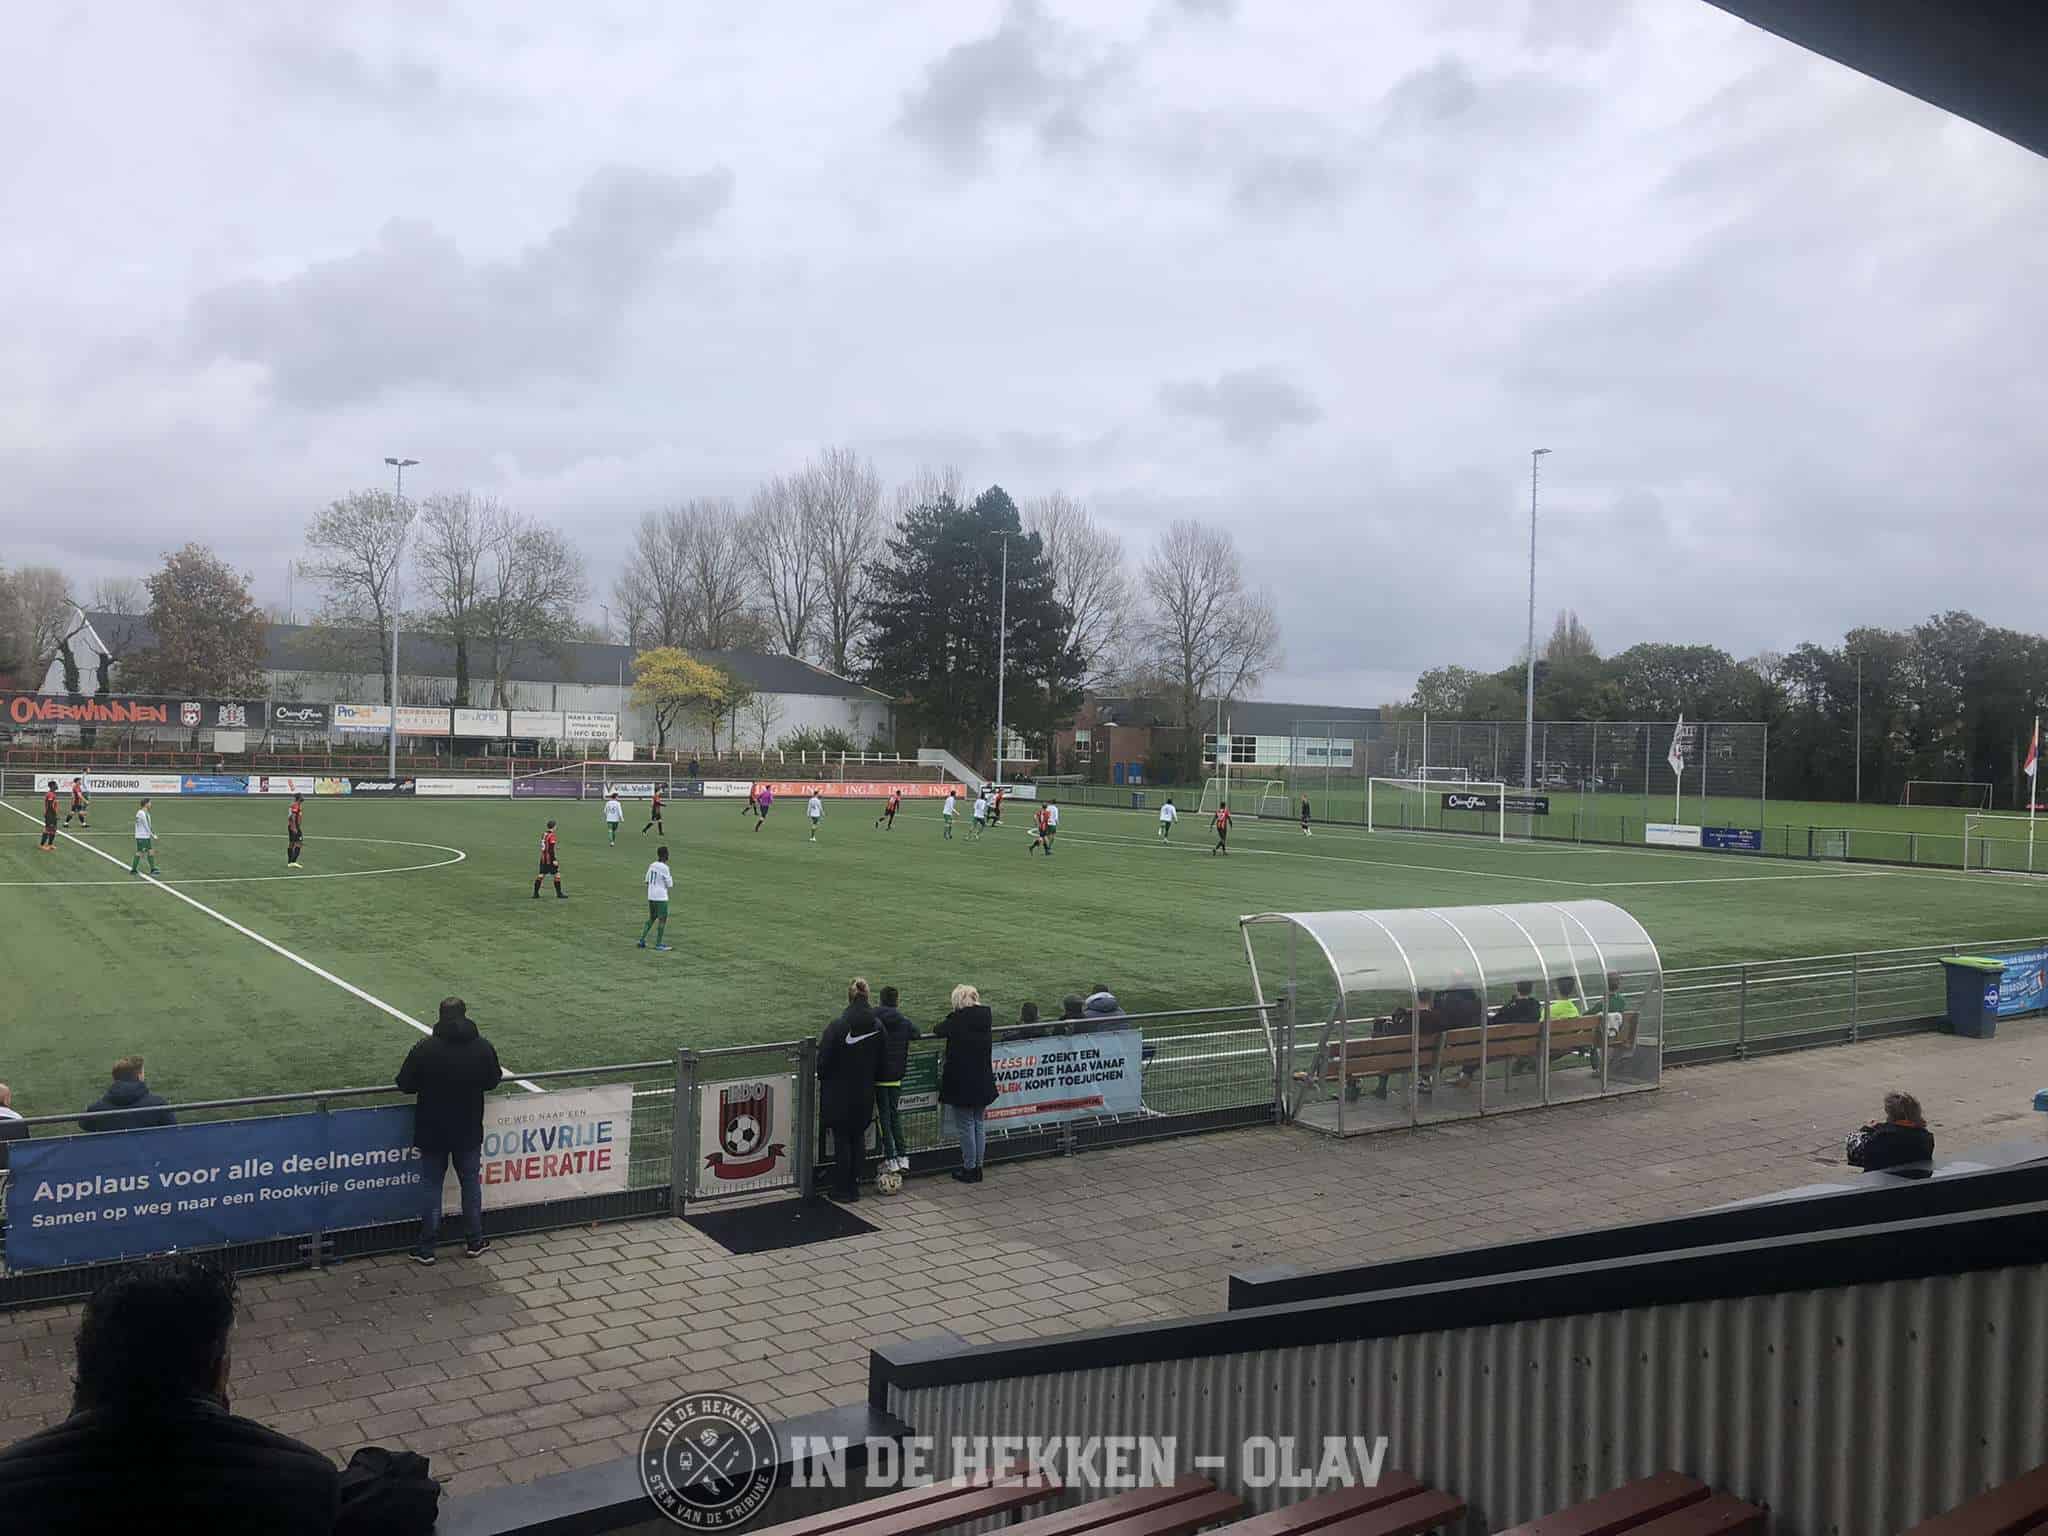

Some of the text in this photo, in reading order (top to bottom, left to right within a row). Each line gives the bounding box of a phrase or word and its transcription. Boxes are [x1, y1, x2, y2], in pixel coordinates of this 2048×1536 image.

[845, 785, 868, 795] ING
[928, 785, 951, 795] ING
[1041, 1051, 1078, 1065] ZOEKT
[1080, 1049, 1100, 1059] EEN
[991, 1058, 1125, 1082] SVADER DIE HAAR VANAF
[1025, 1078, 1056, 1091] KOMT
[1059, 1070, 1123, 1087] TOEJUICHEN
[727, 1082, 766, 1104] EDO
[483, 1121, 612, 1157] OOKVRIJE
[33, 1146, 422, 1203] Applaus voor alle deelnemers
[32, 1171, 421, 1228] Samen op weg naar een Rookvrije Generatie
